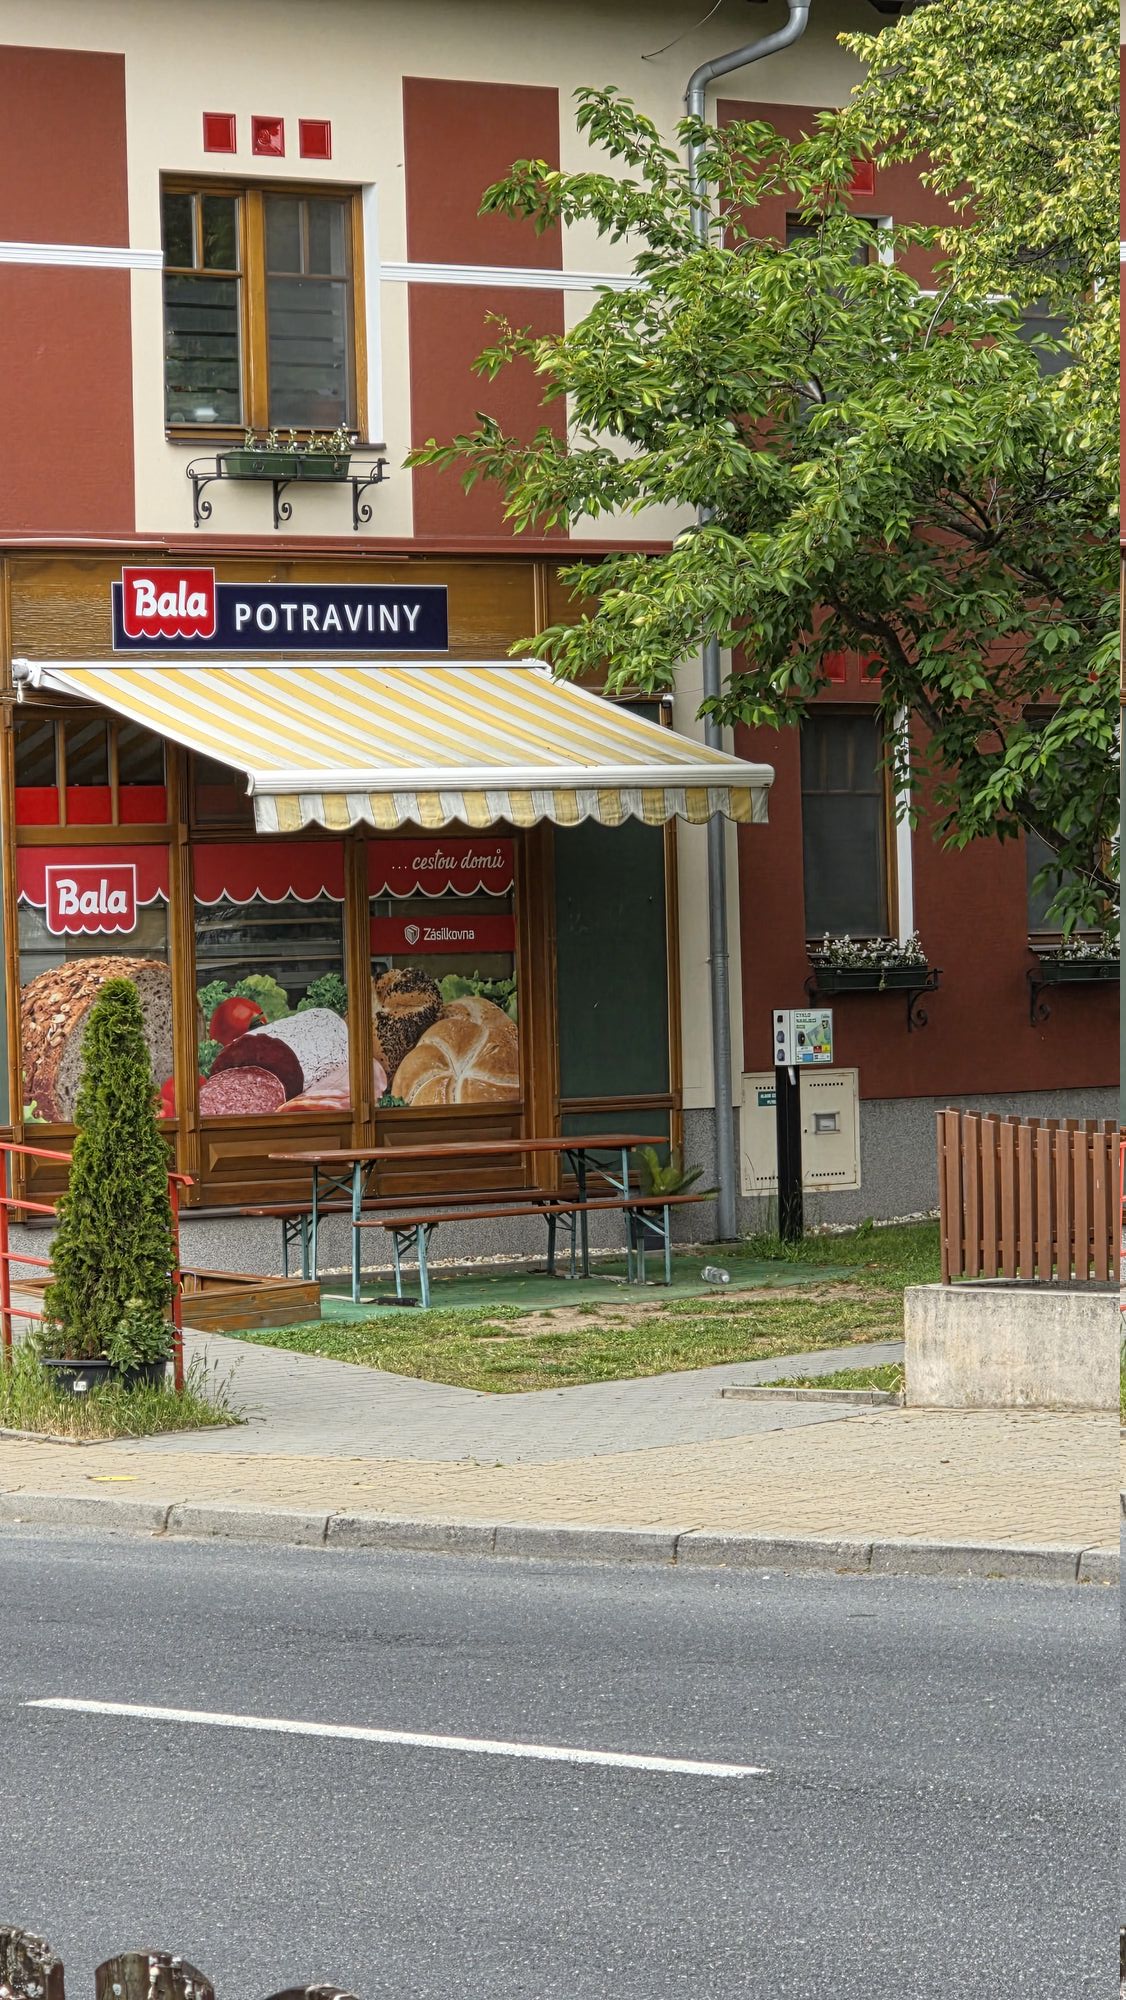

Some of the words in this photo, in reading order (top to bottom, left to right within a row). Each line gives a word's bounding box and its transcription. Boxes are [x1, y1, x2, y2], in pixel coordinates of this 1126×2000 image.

[133, 579, 208, 617] Bala
[235, 603, 421, 632] POTRAVINY
[412, 849, 458, 870] cestou
[461, 848, 505, 869] domů
[56, 879, 127, 915] Bala
[423, 927, 475, 941] Zásilkovna
